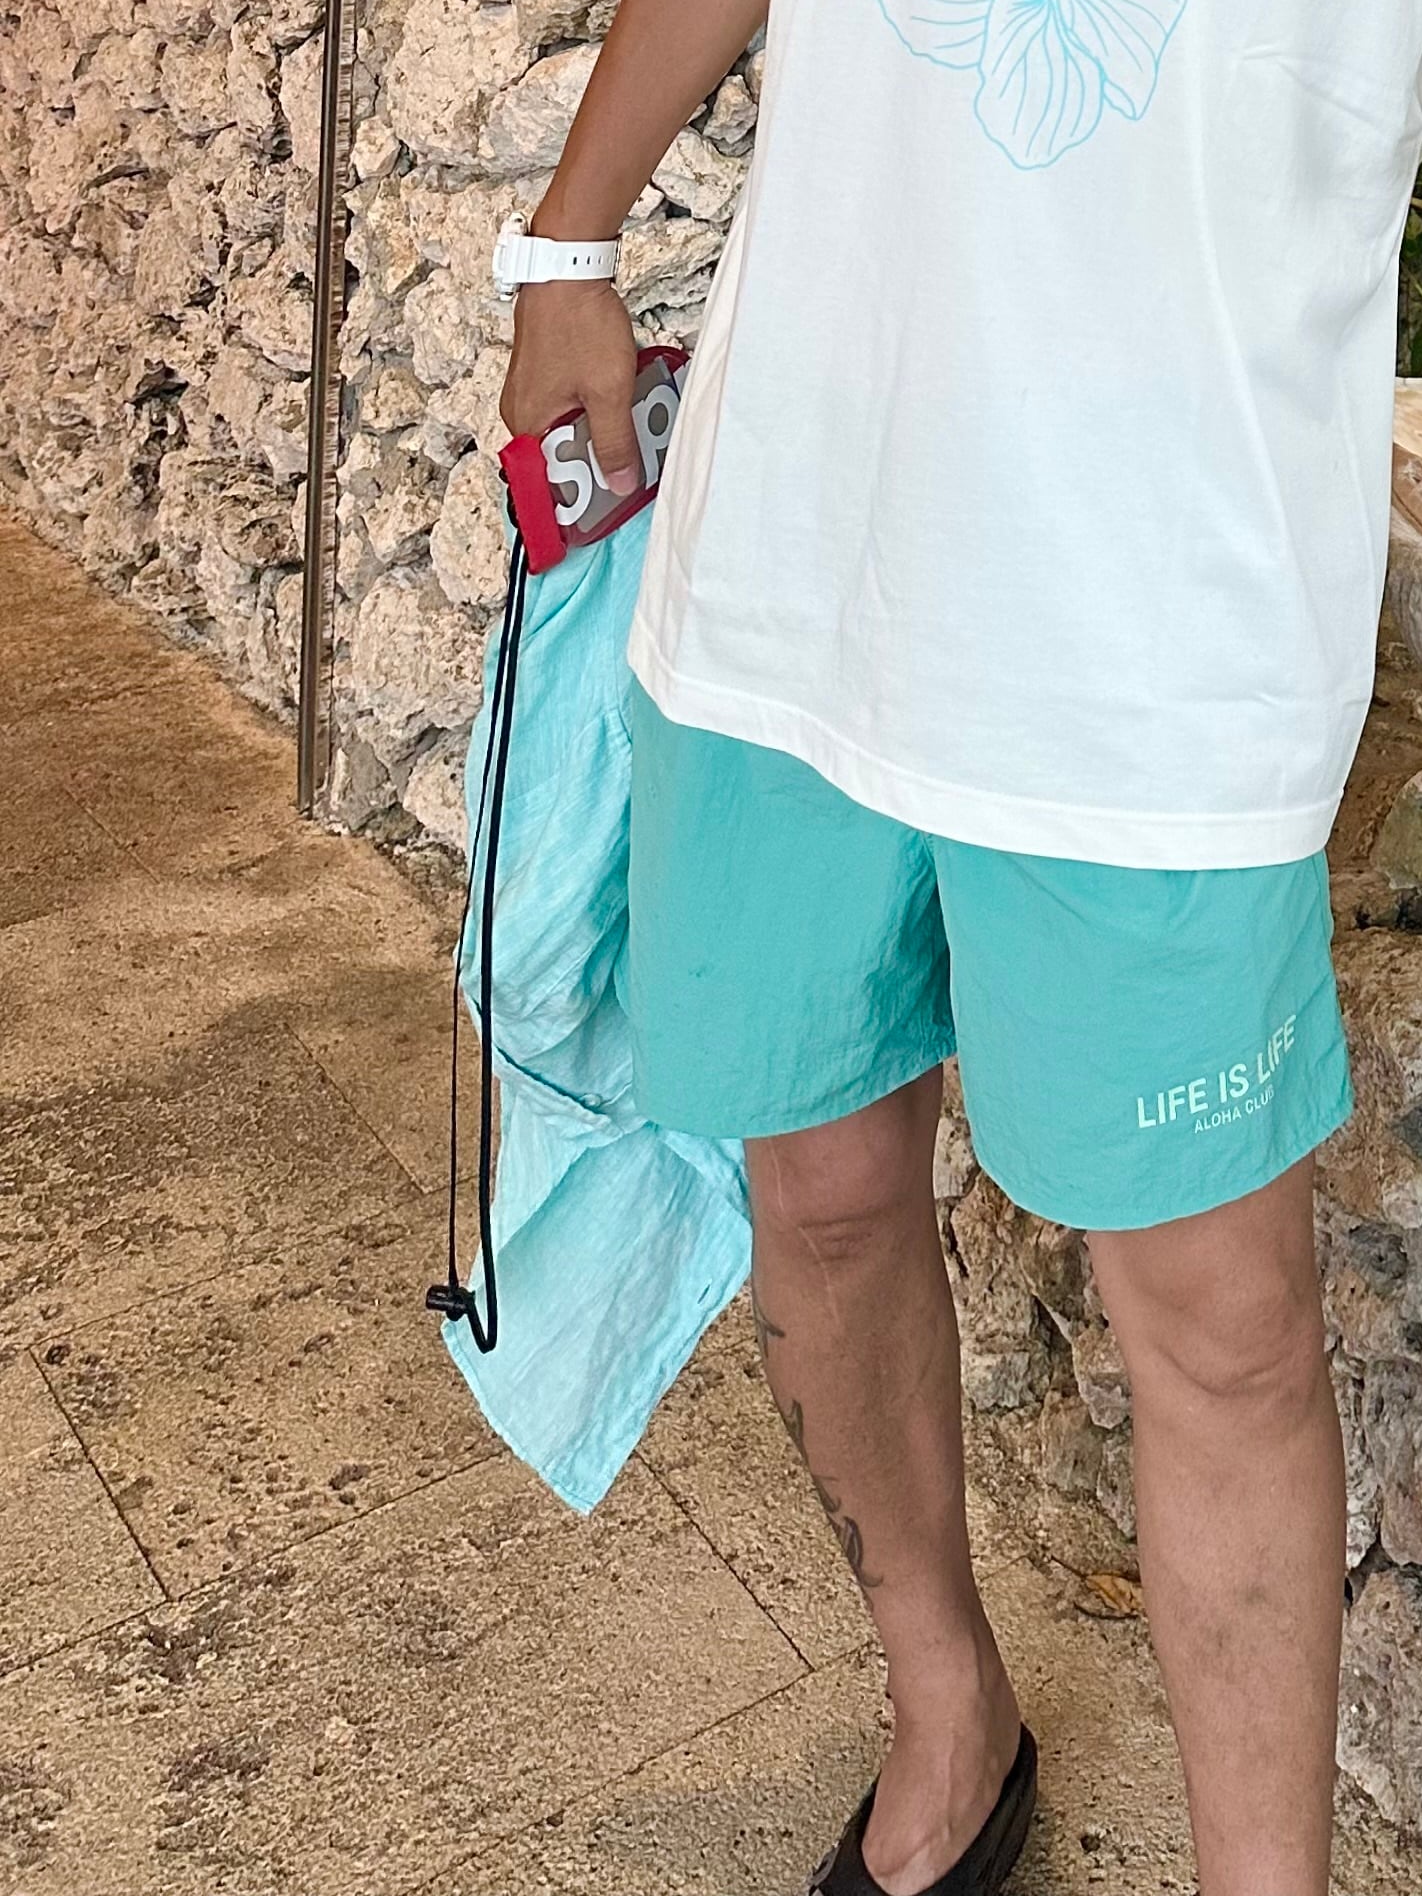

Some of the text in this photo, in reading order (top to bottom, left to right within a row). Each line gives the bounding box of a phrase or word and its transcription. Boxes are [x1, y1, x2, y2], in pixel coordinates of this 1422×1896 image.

[1137, 1014, 1297, 1129] LIFE IS LIFE
[1194, 1086, 1275, 1134] ALOHA CLUB
